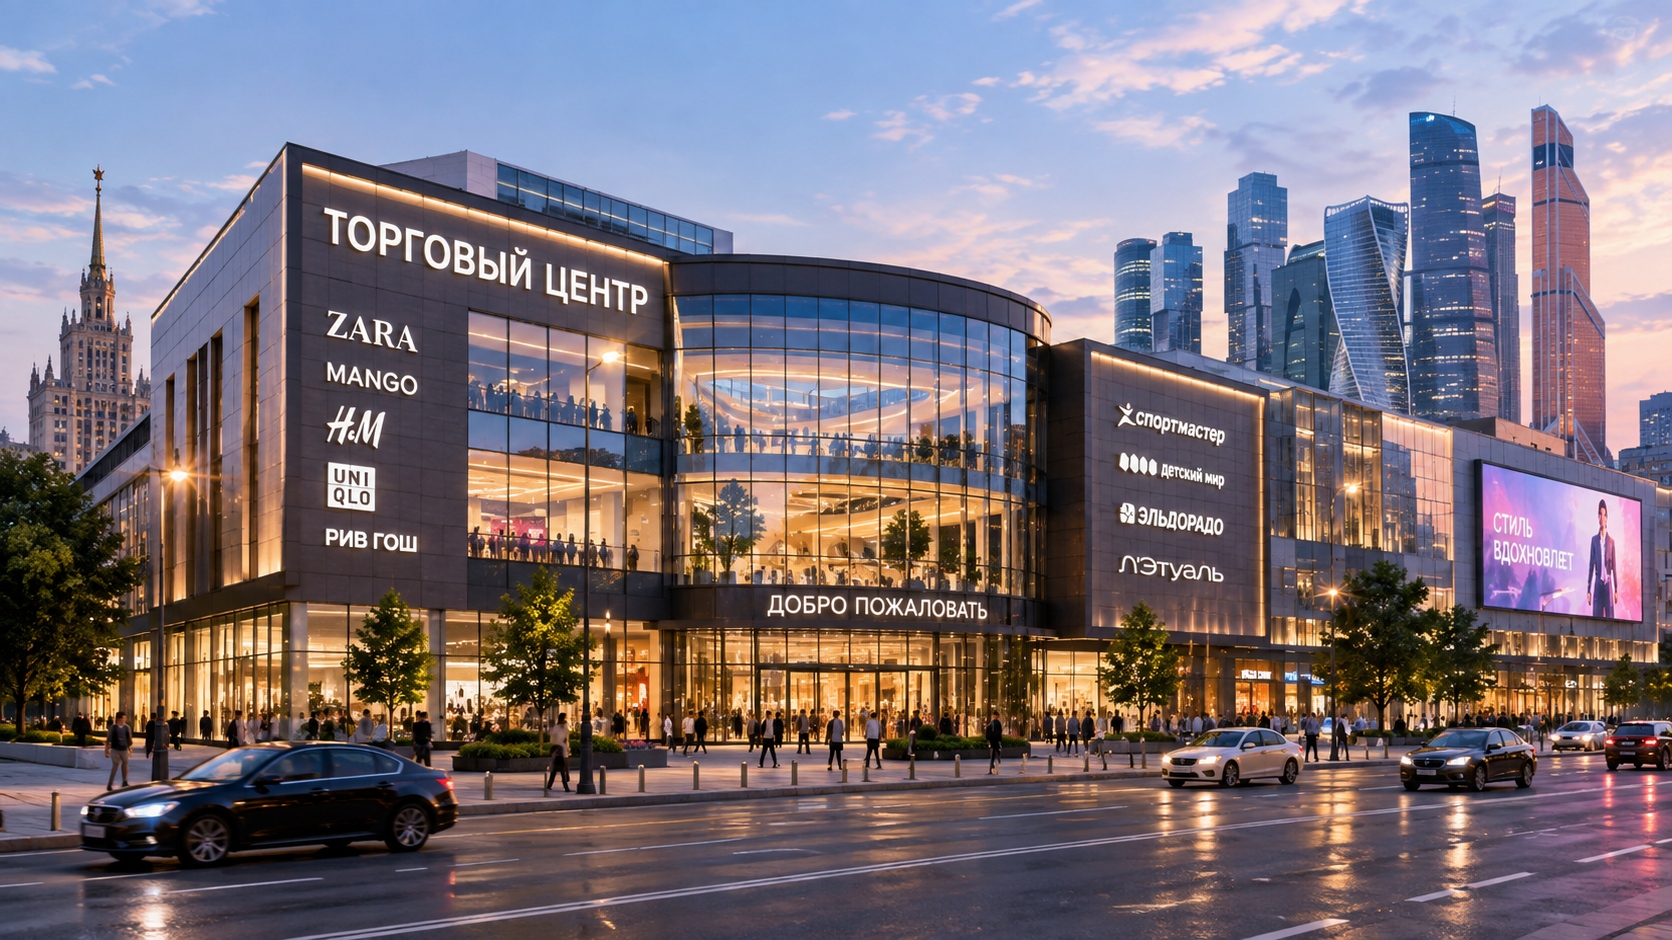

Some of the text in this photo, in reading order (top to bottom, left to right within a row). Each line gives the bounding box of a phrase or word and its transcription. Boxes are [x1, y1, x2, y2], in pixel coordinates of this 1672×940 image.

[323, 207, 649, 315] ТОРГОВЫЙ ЦЕНТР
[326, 310, 419, 353] ZARA
[326, 361, 418, 396] MANGO
[326, 405, 386, 449] H&M
[1135, 411, 1226, 447] спортмастер
[333, 468, 369, 487] UNI
[1160, 463, 1225, 490] детский мир
[333, 485, 371, 507] QLO
[1137, 506, 1225, 536] ЭЛЬДОРАДО
[1493, 512, 1533, 539] СТИЛЬ
[325, 528, 418, 553] РИВ ГОШ
[767, 594, 988, 620] ДОБРО ПОЖАЛОВАТЬ
